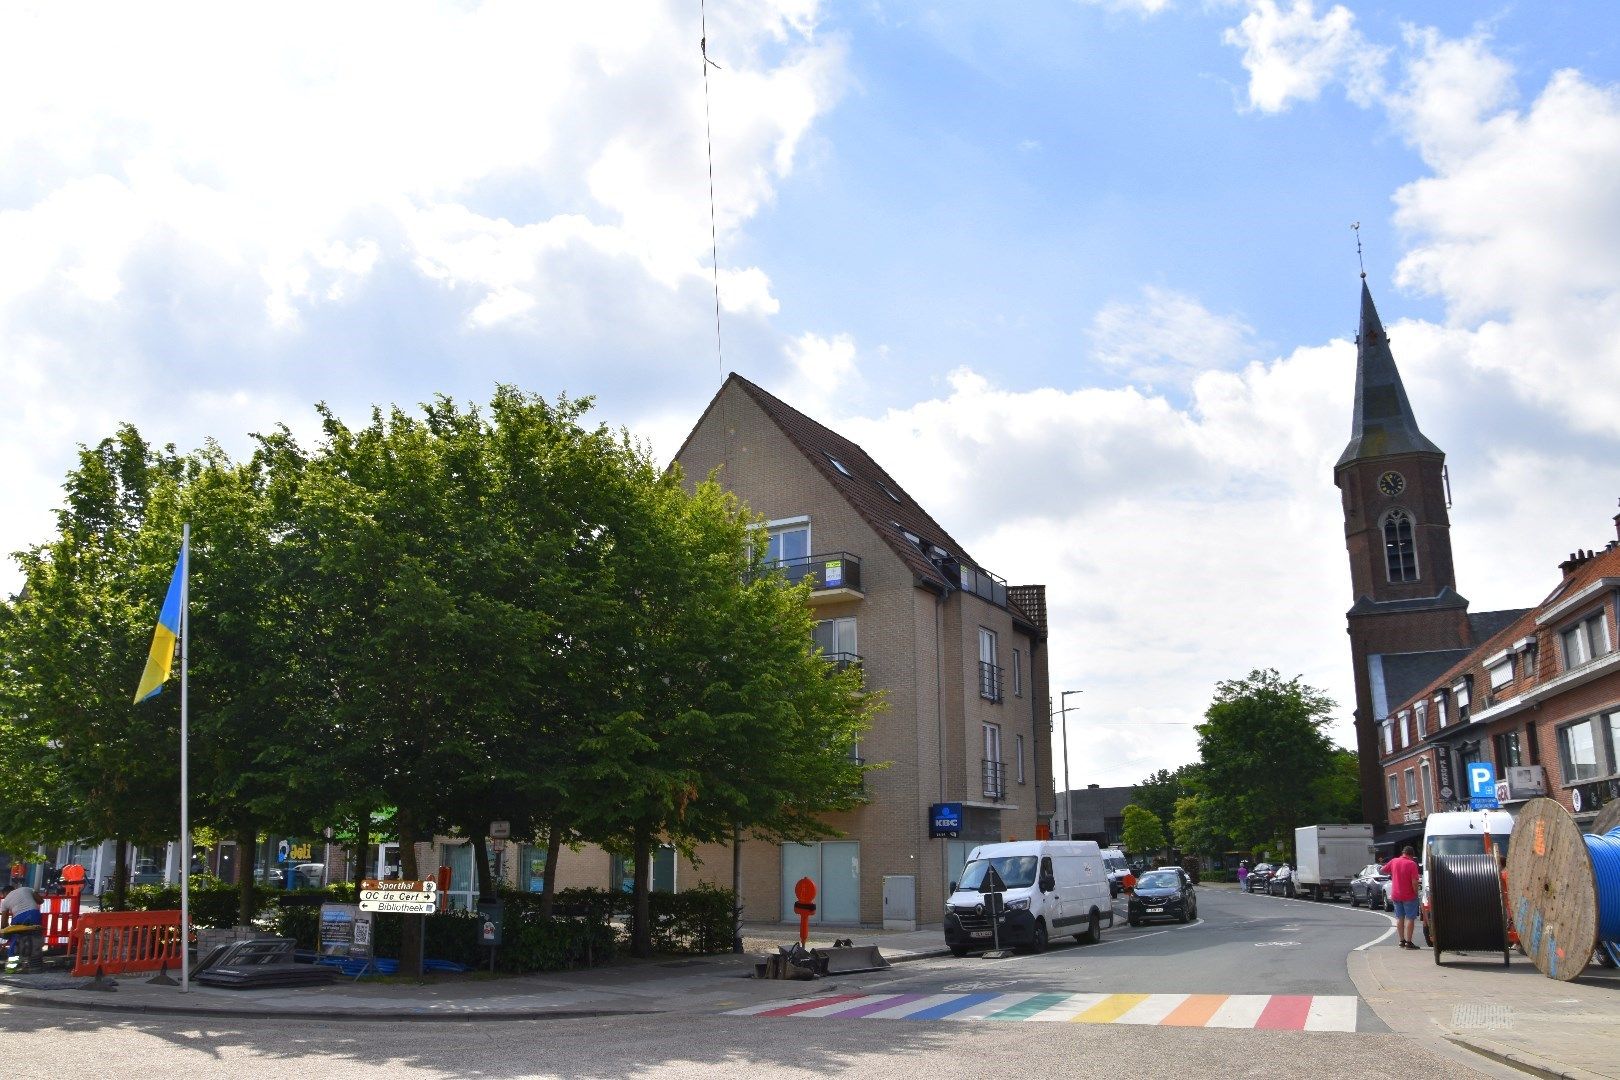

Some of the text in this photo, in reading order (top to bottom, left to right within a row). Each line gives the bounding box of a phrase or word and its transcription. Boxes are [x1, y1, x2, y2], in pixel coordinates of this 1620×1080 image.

[1471, 768, 1491, 793] P
[935, 819, 958, 827] KBC
[377, 881, 415, 891] Sporthal
[365, 891, 419, 901] OC de Cerf
[377, 902, 424, 912] Bibliotheek
